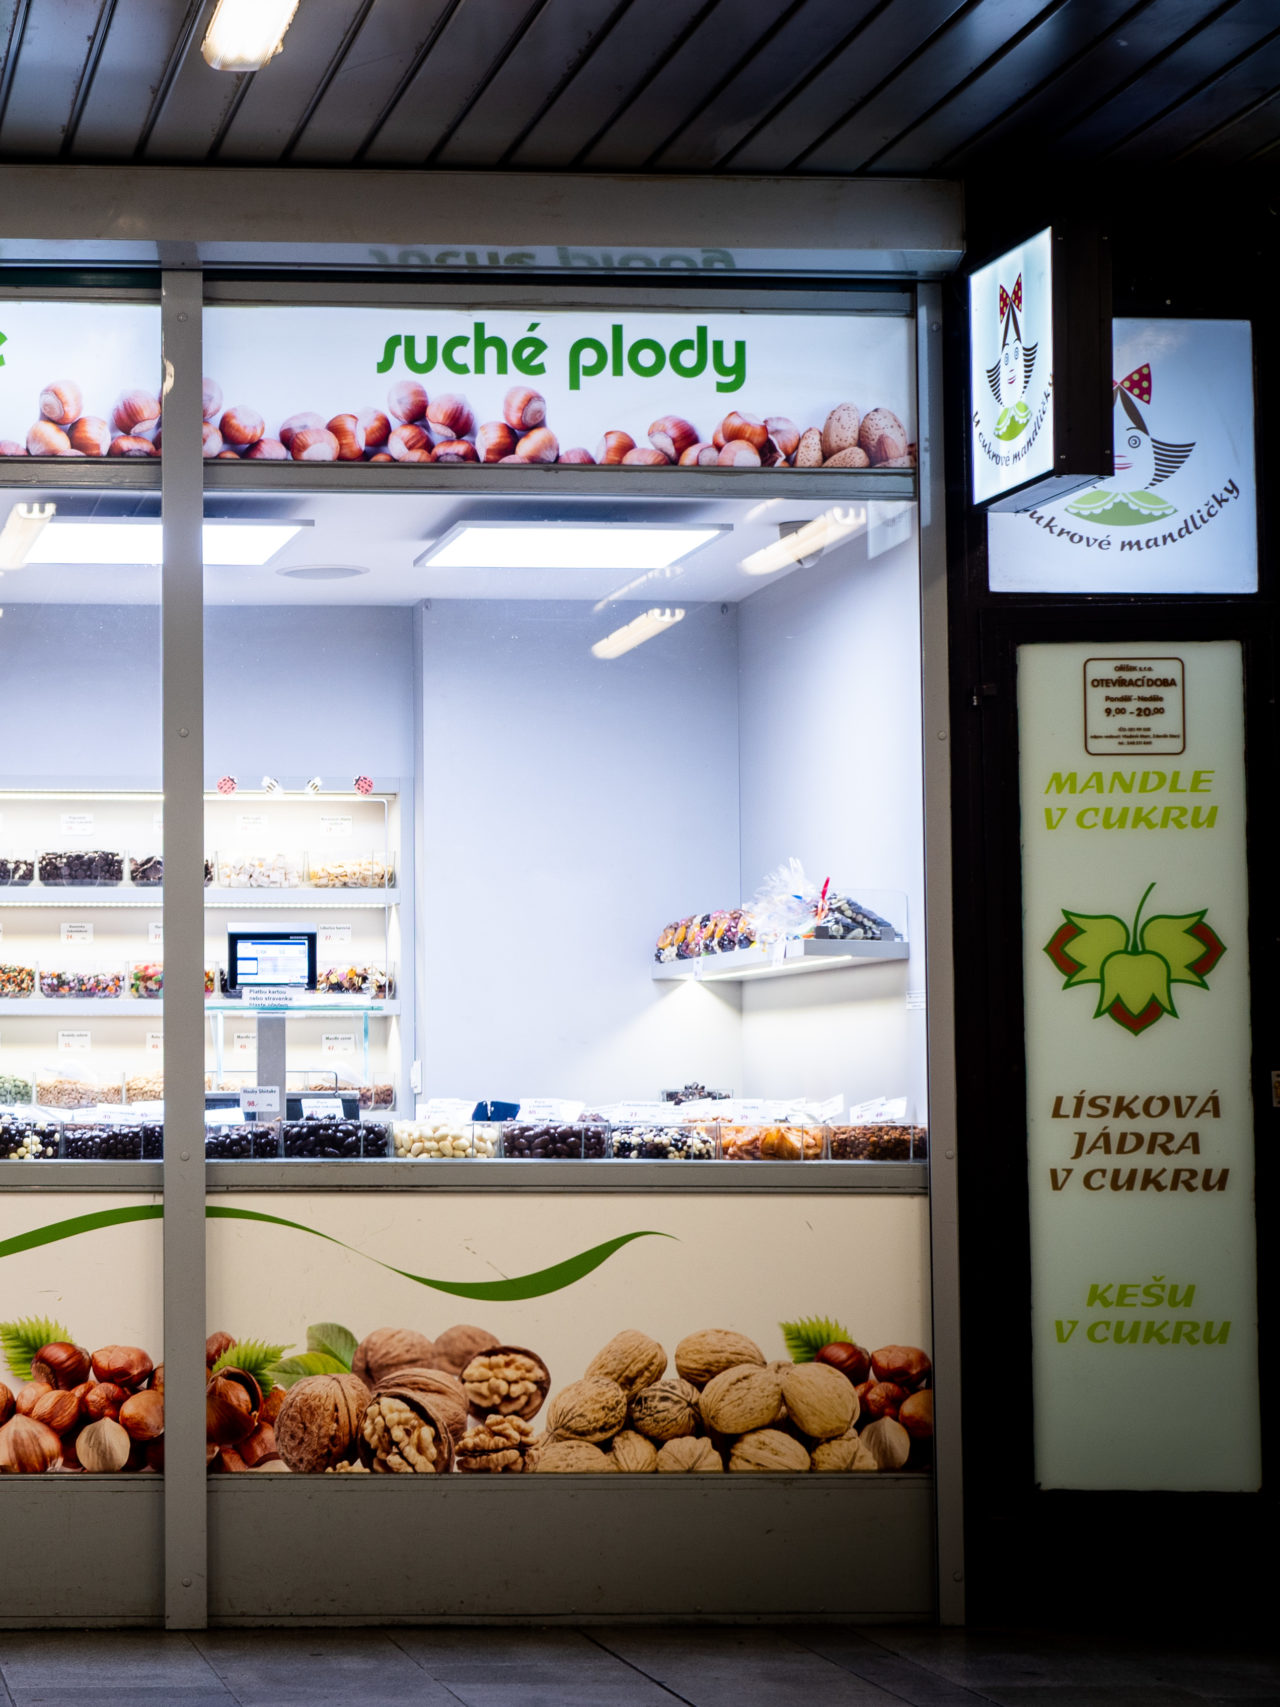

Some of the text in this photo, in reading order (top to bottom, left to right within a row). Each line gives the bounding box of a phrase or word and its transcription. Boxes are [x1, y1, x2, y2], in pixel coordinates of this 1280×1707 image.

[376, 322, 746, 393] suché plody
[1028, 479, 1240, 551] ukrové mandličky
[1091, 676, 1177, 688] OTEVÍRACÍ DOBA
[1044, 770, 1215, 794] MANDLE
[1044, 805, 1218, 830] V CUKRU
[1051, 1089, 1221, 1119] LÍSKOVÁ
[1070, 1126, 1201, 1160] JÁDRA
[1049, 1167, 1230, 1192] V CUKRU
[1086, 1275, 1196, 1308] KEŠU
[1054, 1319, 1231, 1345] V CUKRU
